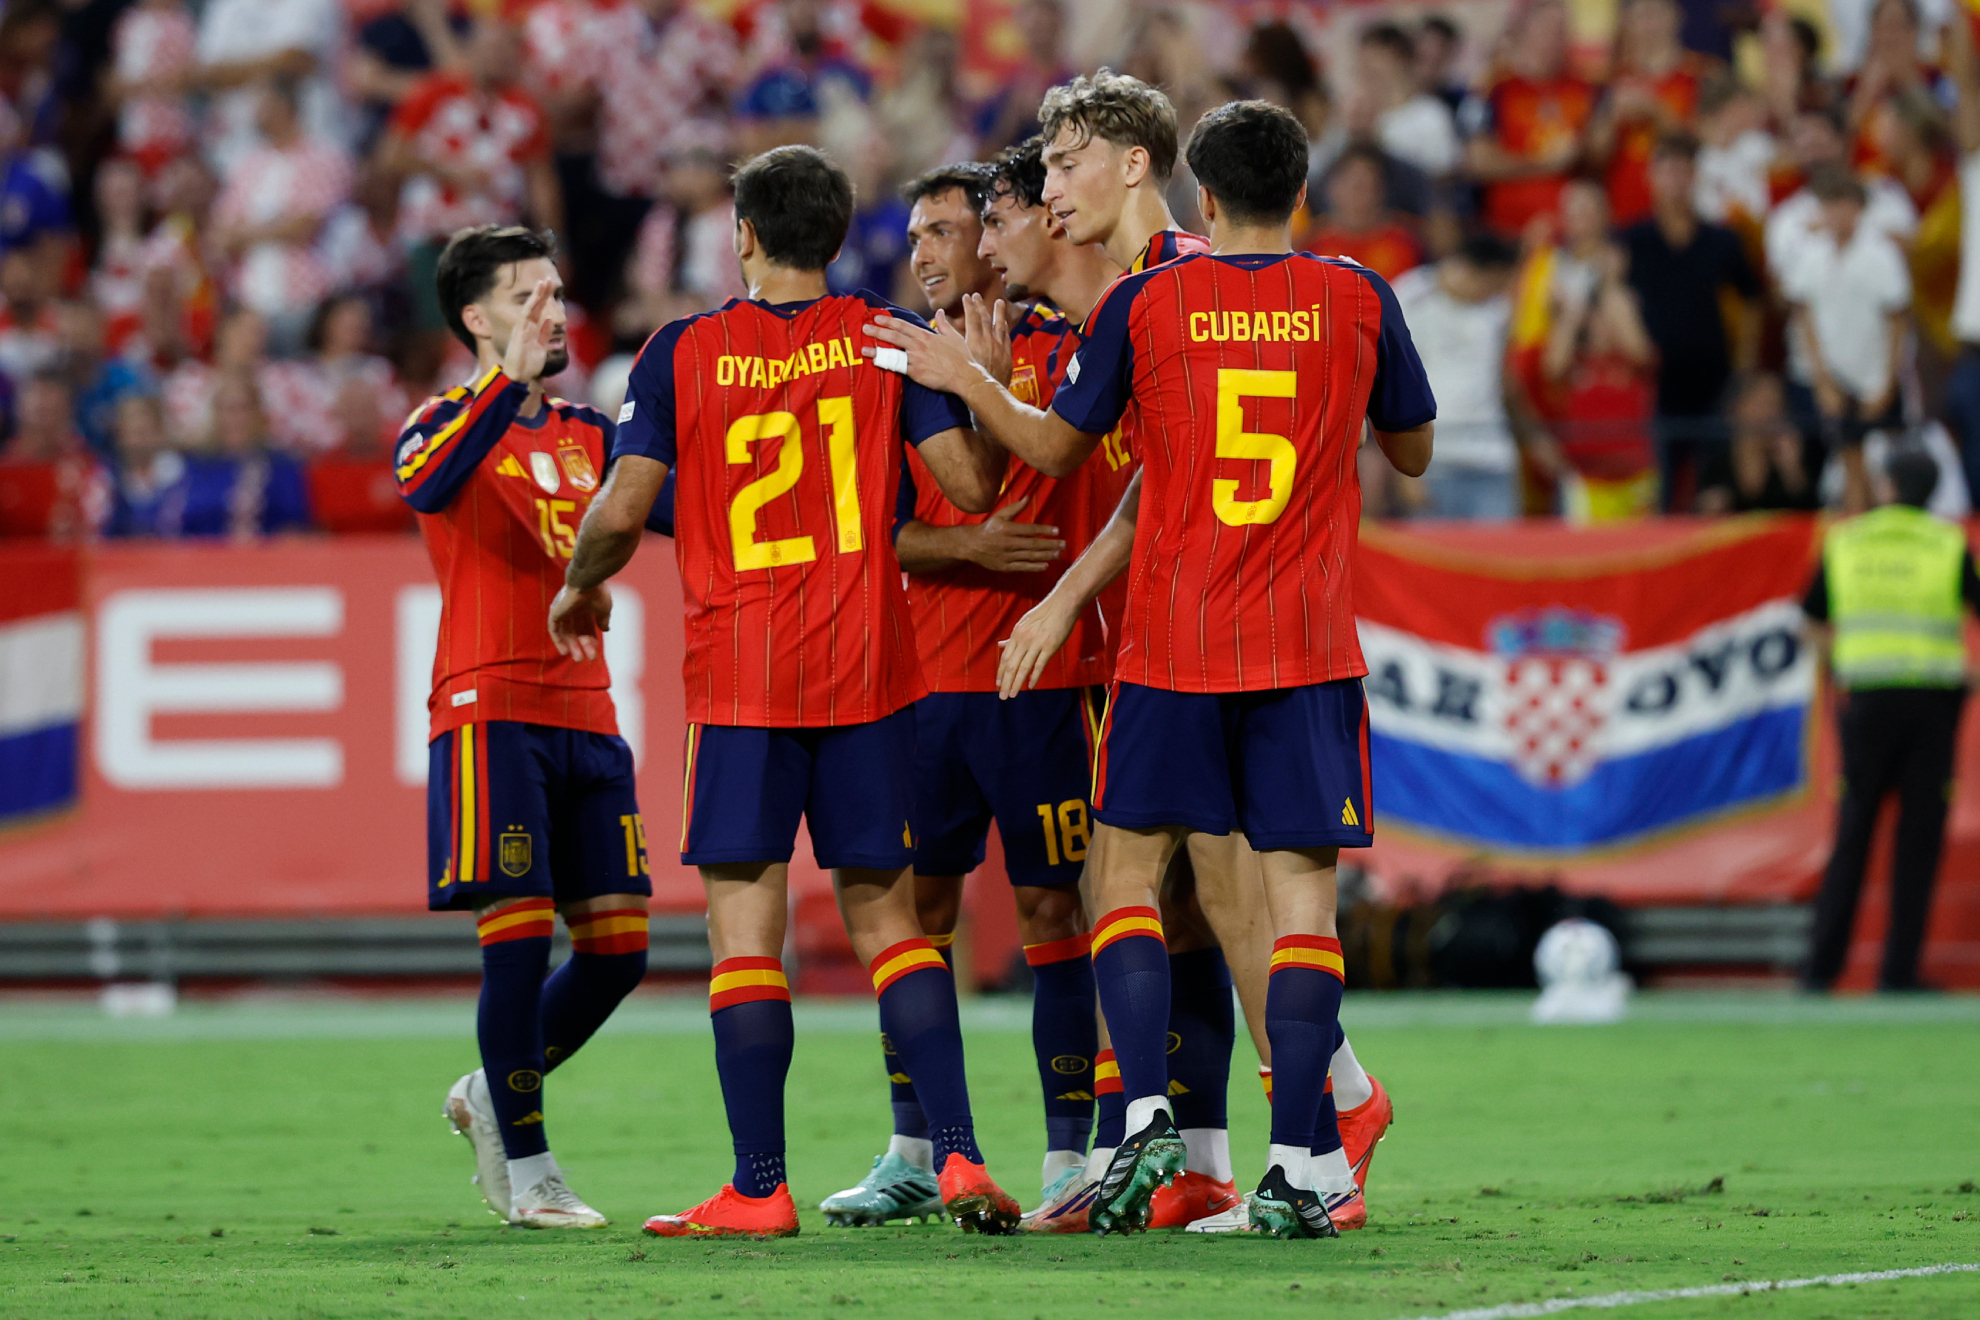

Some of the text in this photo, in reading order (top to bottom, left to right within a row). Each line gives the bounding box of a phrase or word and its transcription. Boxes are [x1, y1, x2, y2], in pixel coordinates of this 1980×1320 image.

[1189, 303, 1321, 343] CUBARSÍ
[1211, 368, 1298, 527] 5
[725, 395, 864, 572] 21
[534, 498, 577, 559] 15
[1036, 798, 1092, 867] 18
